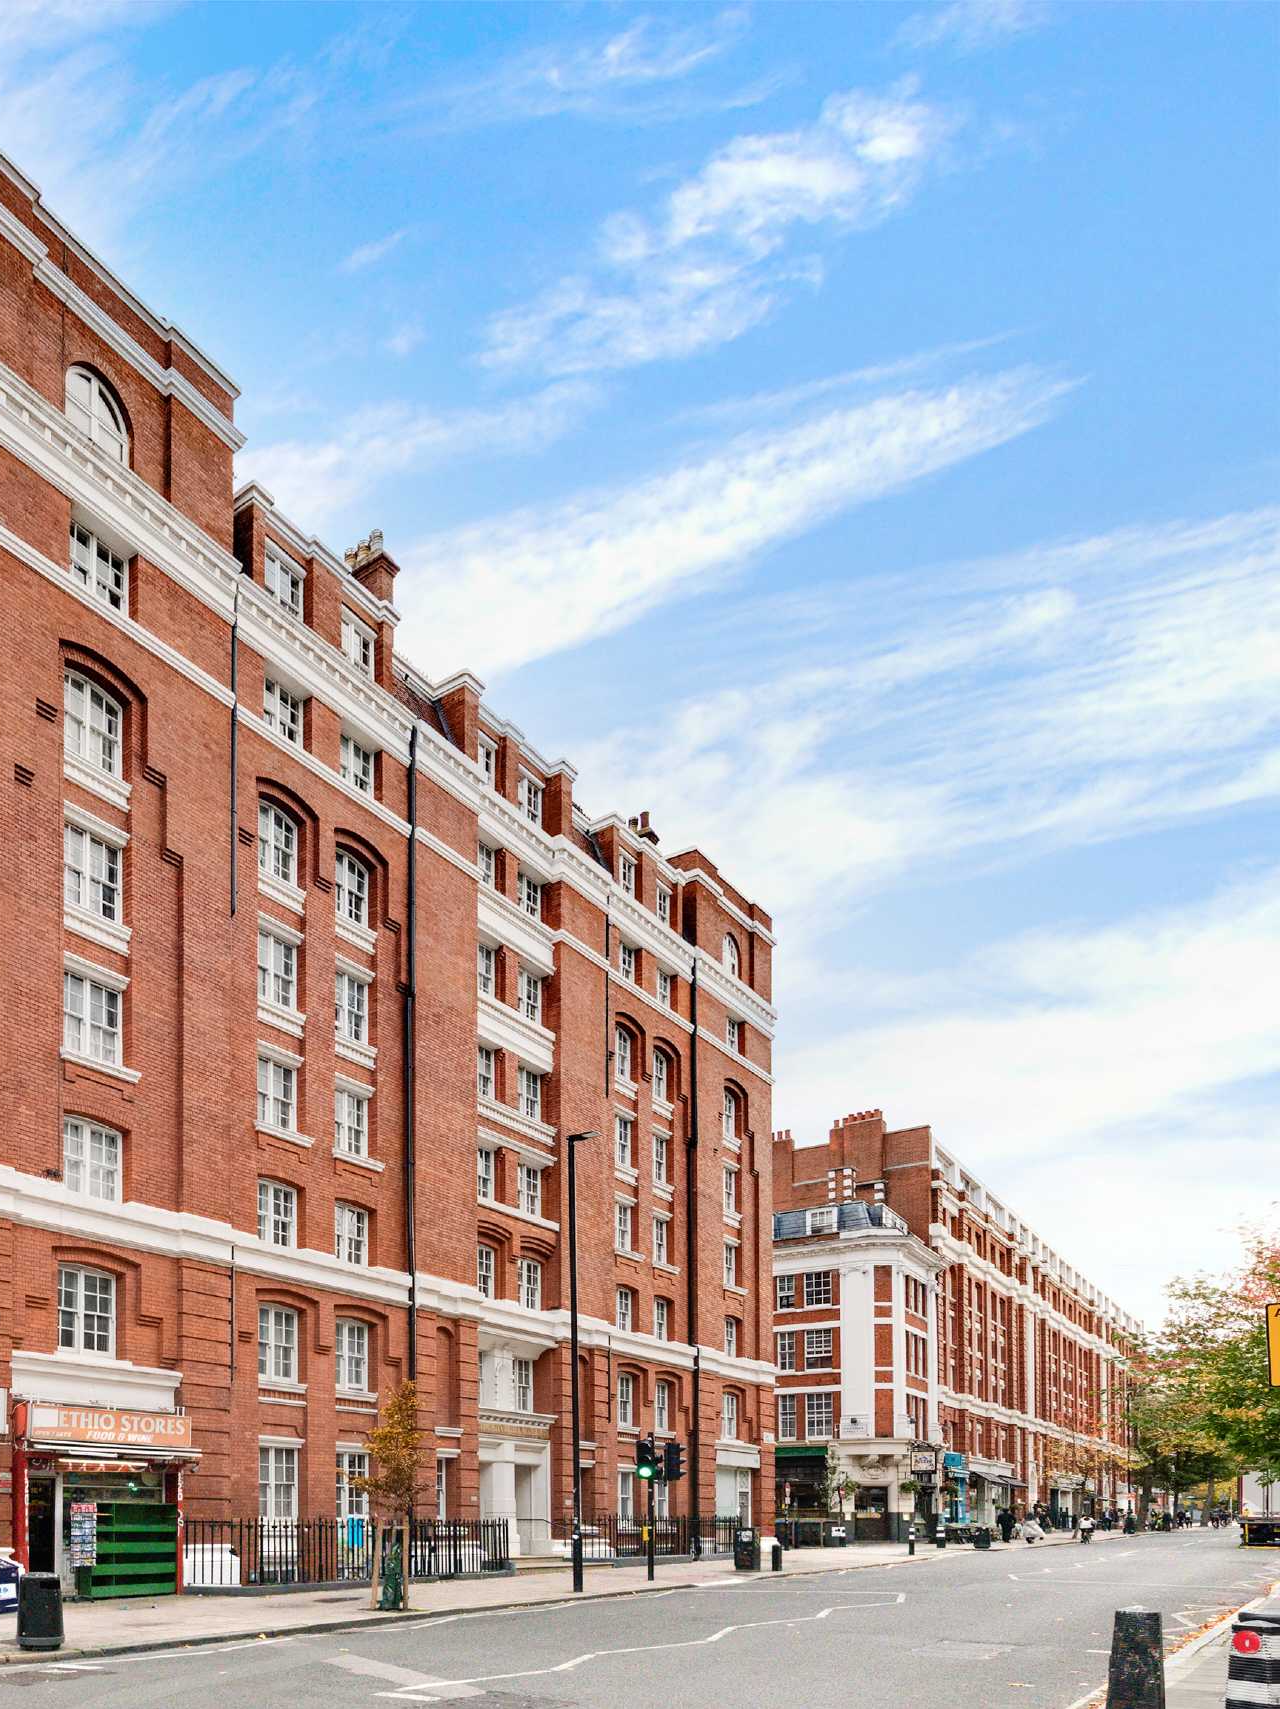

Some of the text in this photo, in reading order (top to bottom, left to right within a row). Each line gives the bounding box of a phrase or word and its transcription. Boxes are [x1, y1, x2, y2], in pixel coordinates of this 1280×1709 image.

[58, 1411, 186, 1436] ETHIO STORES
[86, 1431, 115, 1442] FOOD
